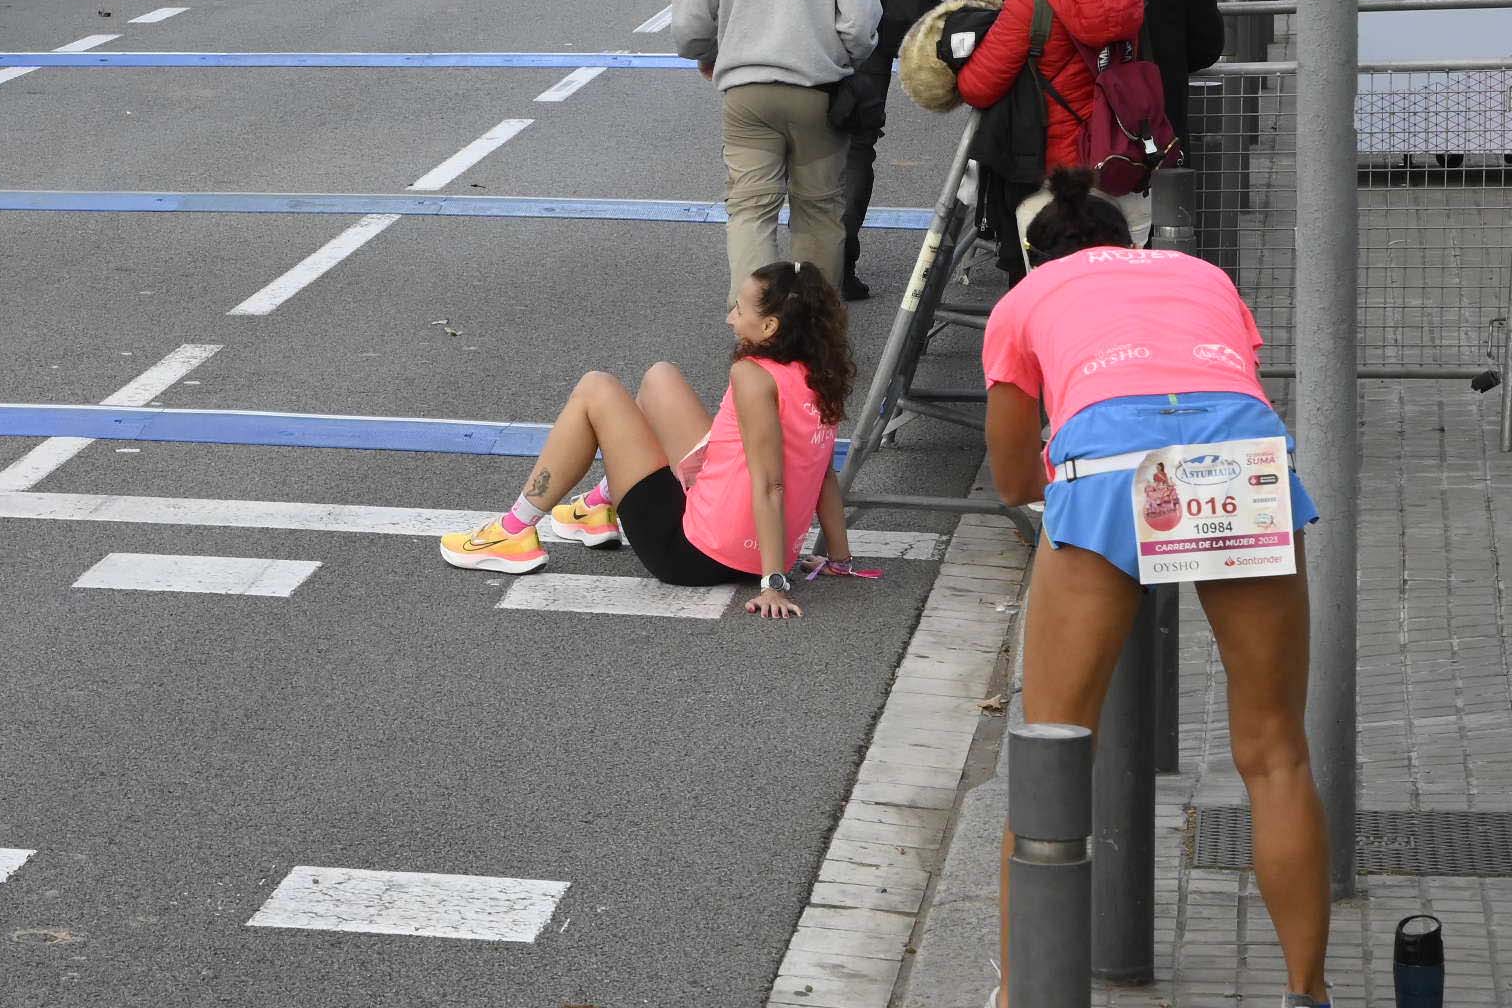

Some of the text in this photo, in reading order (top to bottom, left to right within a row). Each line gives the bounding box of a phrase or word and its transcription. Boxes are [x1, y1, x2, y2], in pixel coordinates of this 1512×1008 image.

[1084, 347, 1150, 375] OYSHO
[1246, 457, 1275, 466] SUMA
[1182, 467, 1236, 480] ASTURIANA
[1186, 496, 1237, 516] 016
[1194, 521, 1233, 534] 10984
[1155, 541, 1197, 552] CARRERA
[1199, 540, 1211, 549] DE
[1212, 539, 1227, 548] LA
[1228, 537, 1255, 547] MUJER
[1153, 555, 1282, 574] OYSHO Santander
